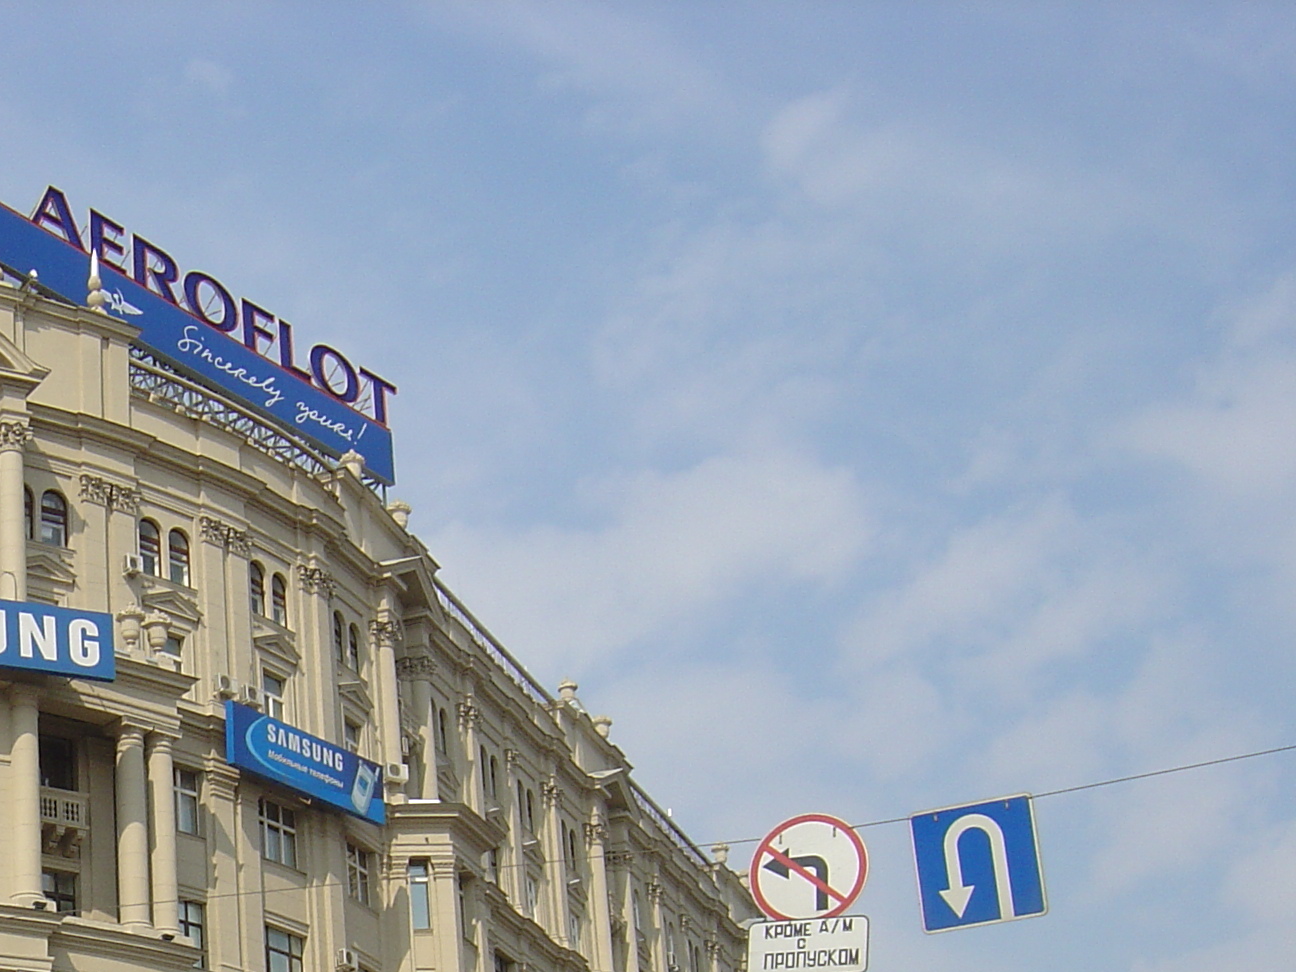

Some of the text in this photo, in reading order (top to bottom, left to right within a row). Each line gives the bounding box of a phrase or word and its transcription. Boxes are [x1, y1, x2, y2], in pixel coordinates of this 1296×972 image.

[30, 185, 397, 426] AEROFLOT
[177, 326, 367, 445] Sincerely yours!
[267, 723, 343, 772] SAMSUNG
[268, 749, 343, 788] Мобильные телефоны
[765, 920, 812, 939] КРОМЕ
[797, 938, 807, 950] С
[763, 948, 860, 970] ПРОПУСКОМ
